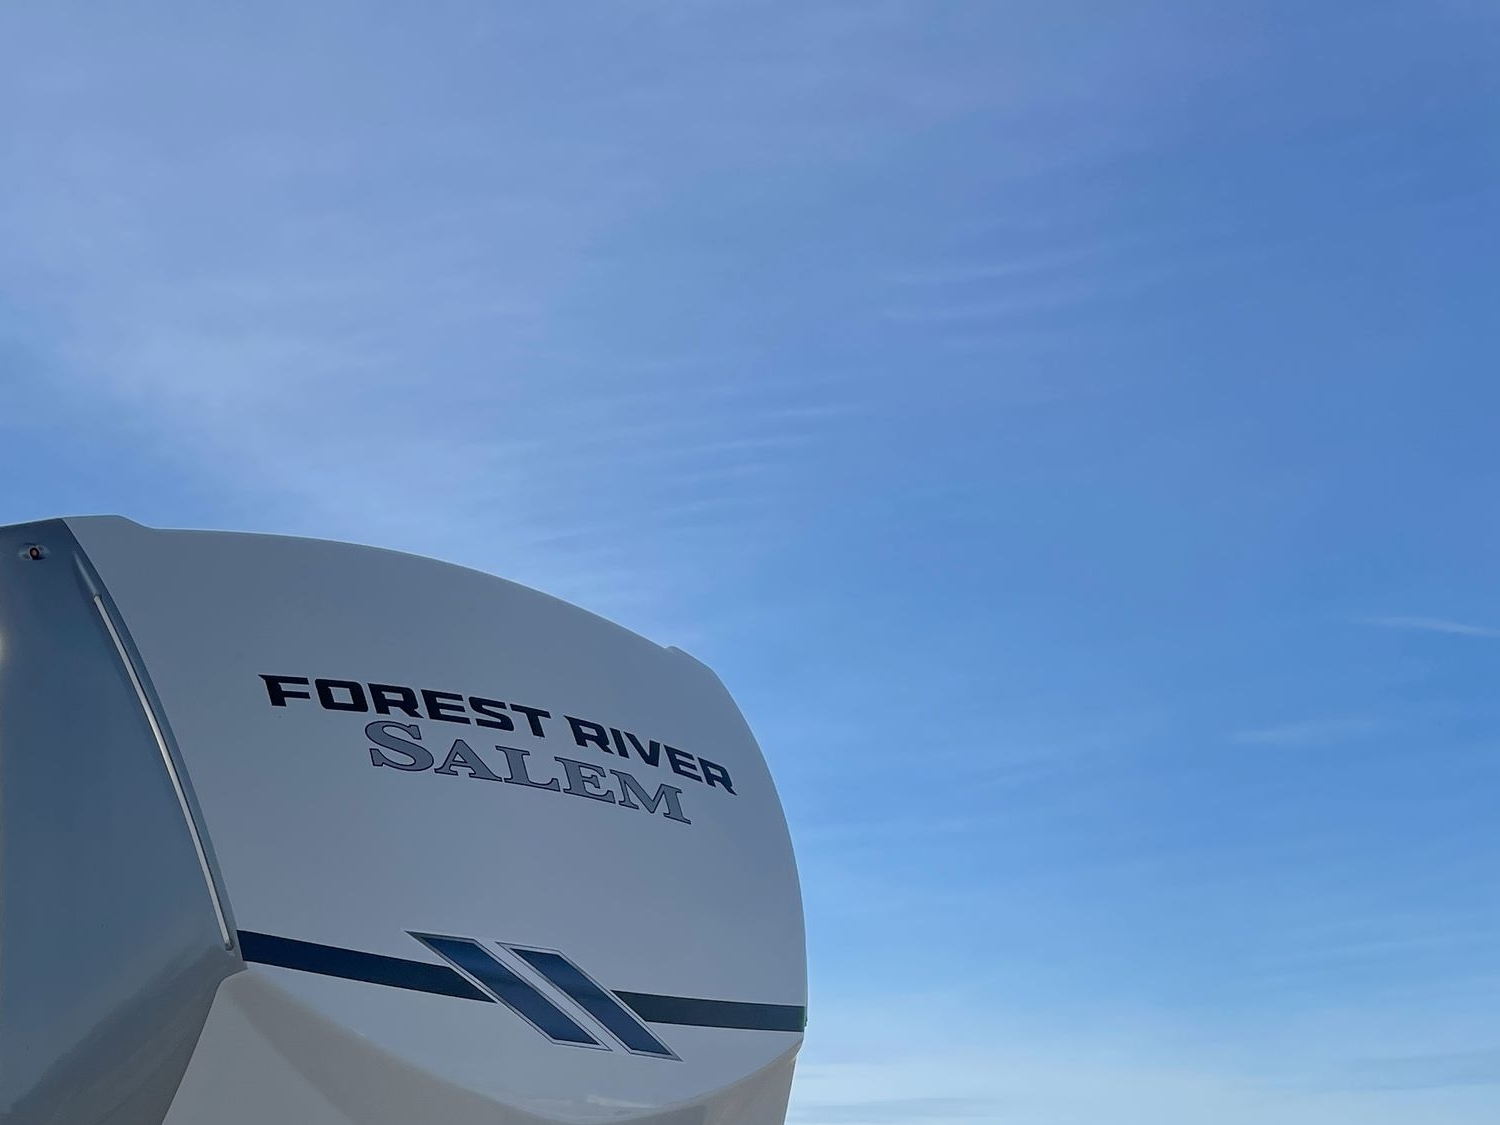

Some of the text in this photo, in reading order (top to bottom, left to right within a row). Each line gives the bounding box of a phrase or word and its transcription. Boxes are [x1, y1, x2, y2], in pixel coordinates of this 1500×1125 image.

[258, 674, 737, 796] FOREST RIVER
[364, 720, 692, 825] SALEM
